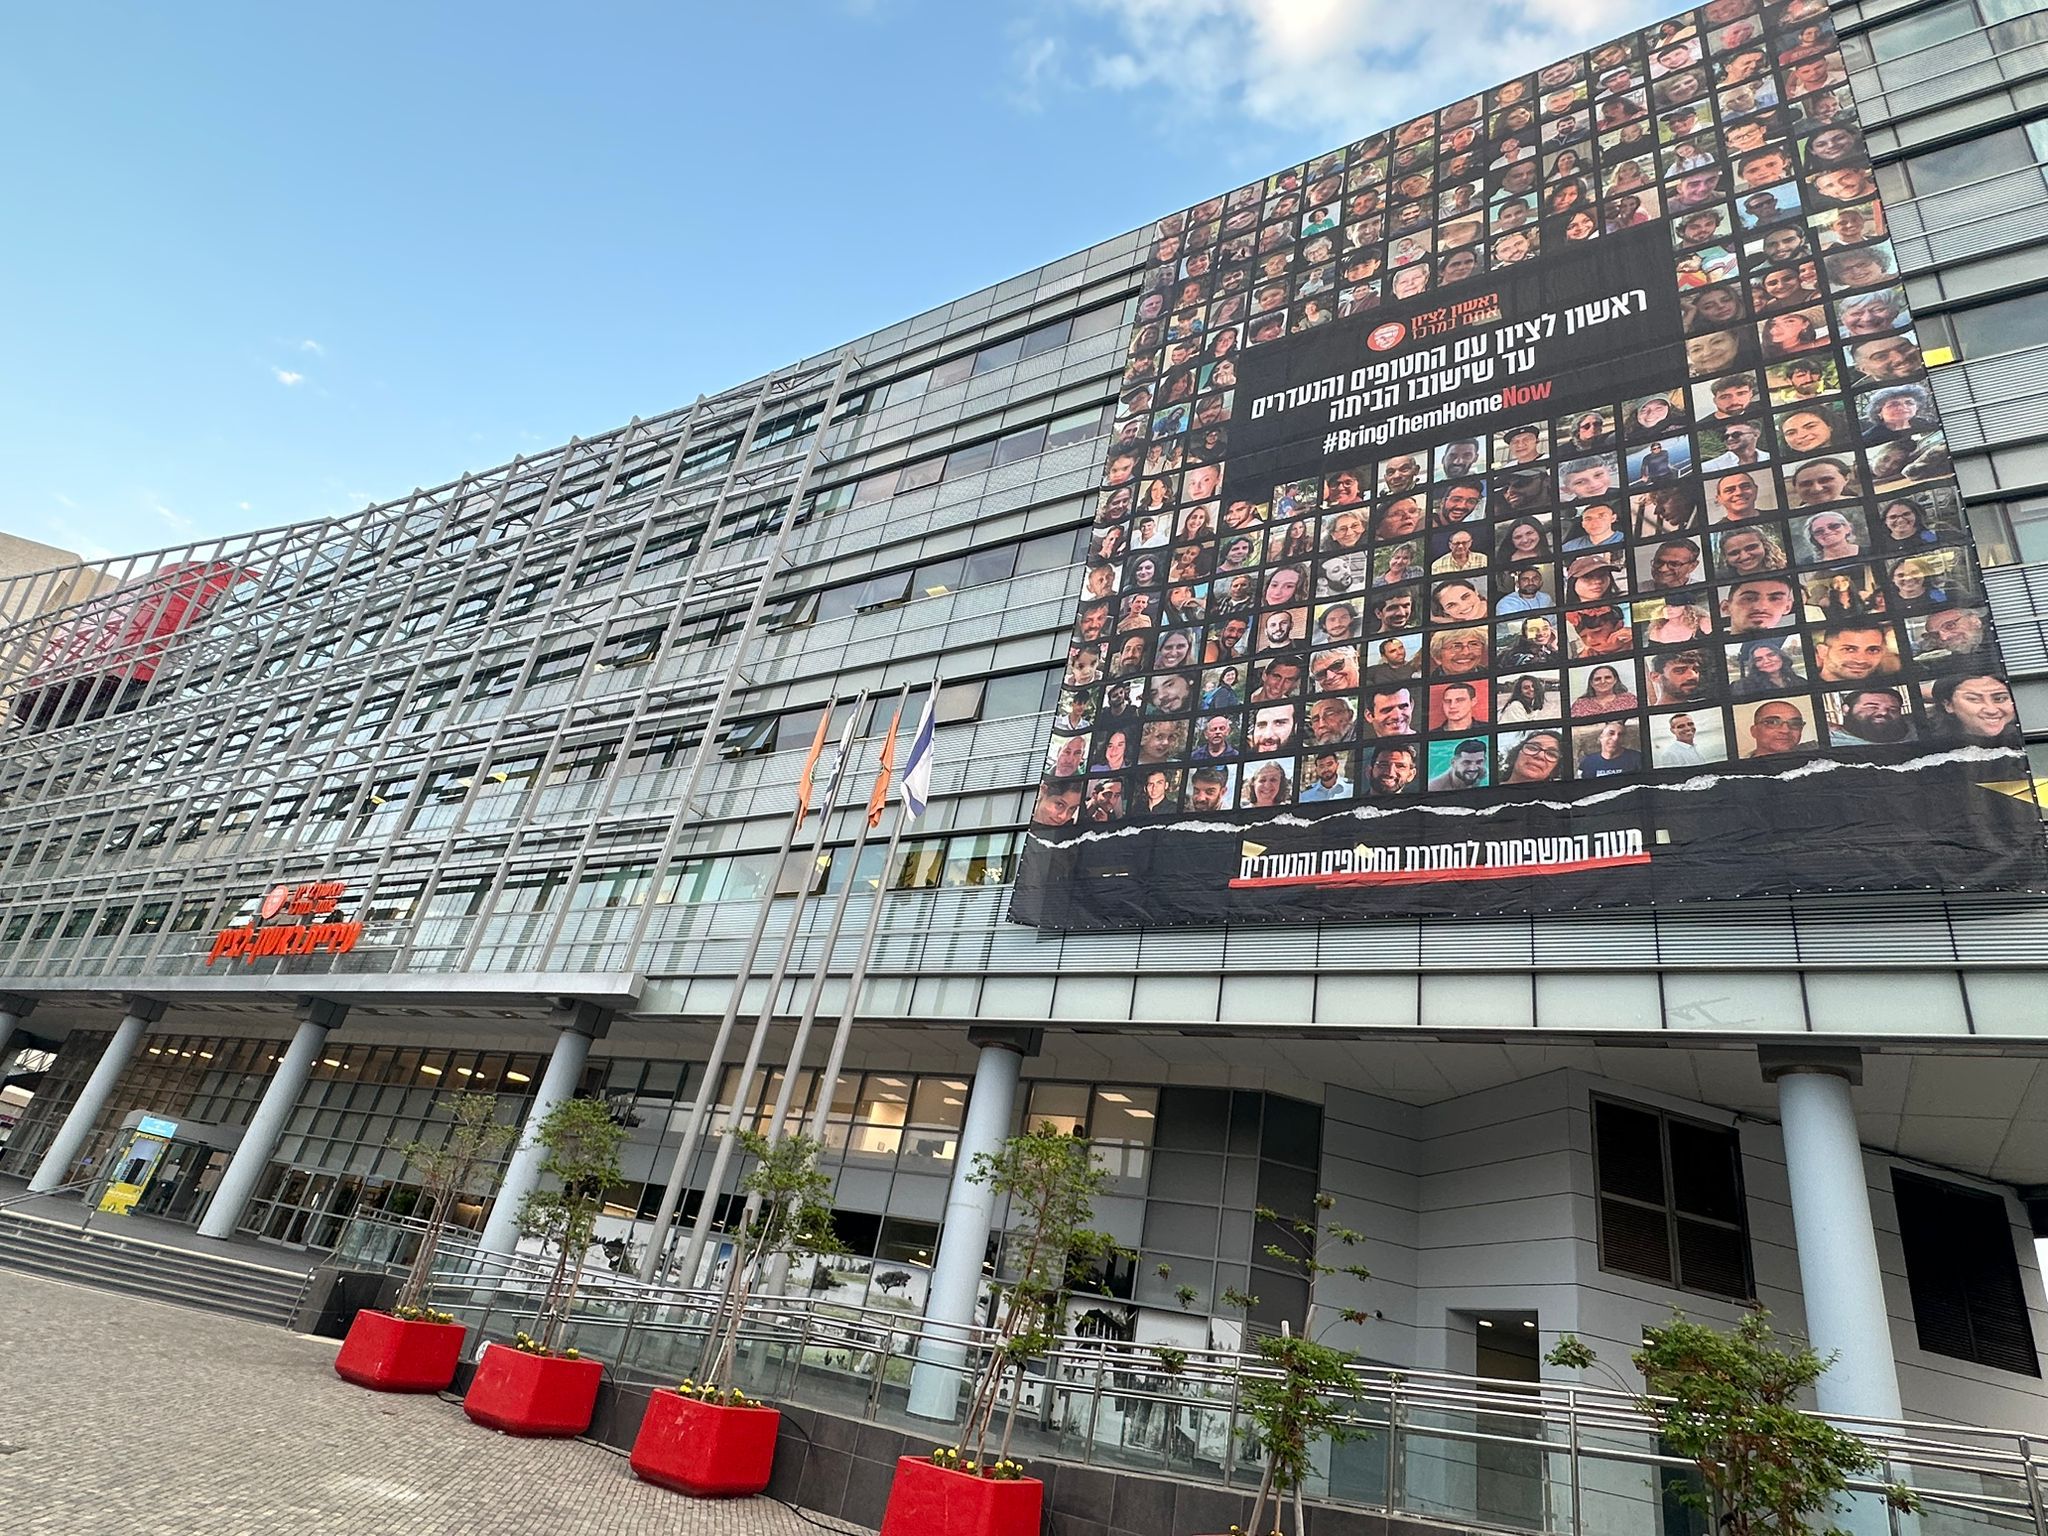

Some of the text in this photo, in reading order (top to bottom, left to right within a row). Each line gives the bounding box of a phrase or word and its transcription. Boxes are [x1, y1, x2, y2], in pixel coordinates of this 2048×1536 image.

[1411, 292, 1498, 330] ראשון לציון
[1412, 318, 1456, 340] במרכז
[1462, 305, 1499, 325] אתם
[1250, 288, 1648, 420] ראשון לציון עם החטופים והנעדרים
[1329, 346, 1535, 422] עד שישובו הביתה
[1322, 381, 1552, 455] #BringThemHomeNow
[1240, 828, 1643, 880] מטה המשפחות להחזרת החטופים והנעדרים
